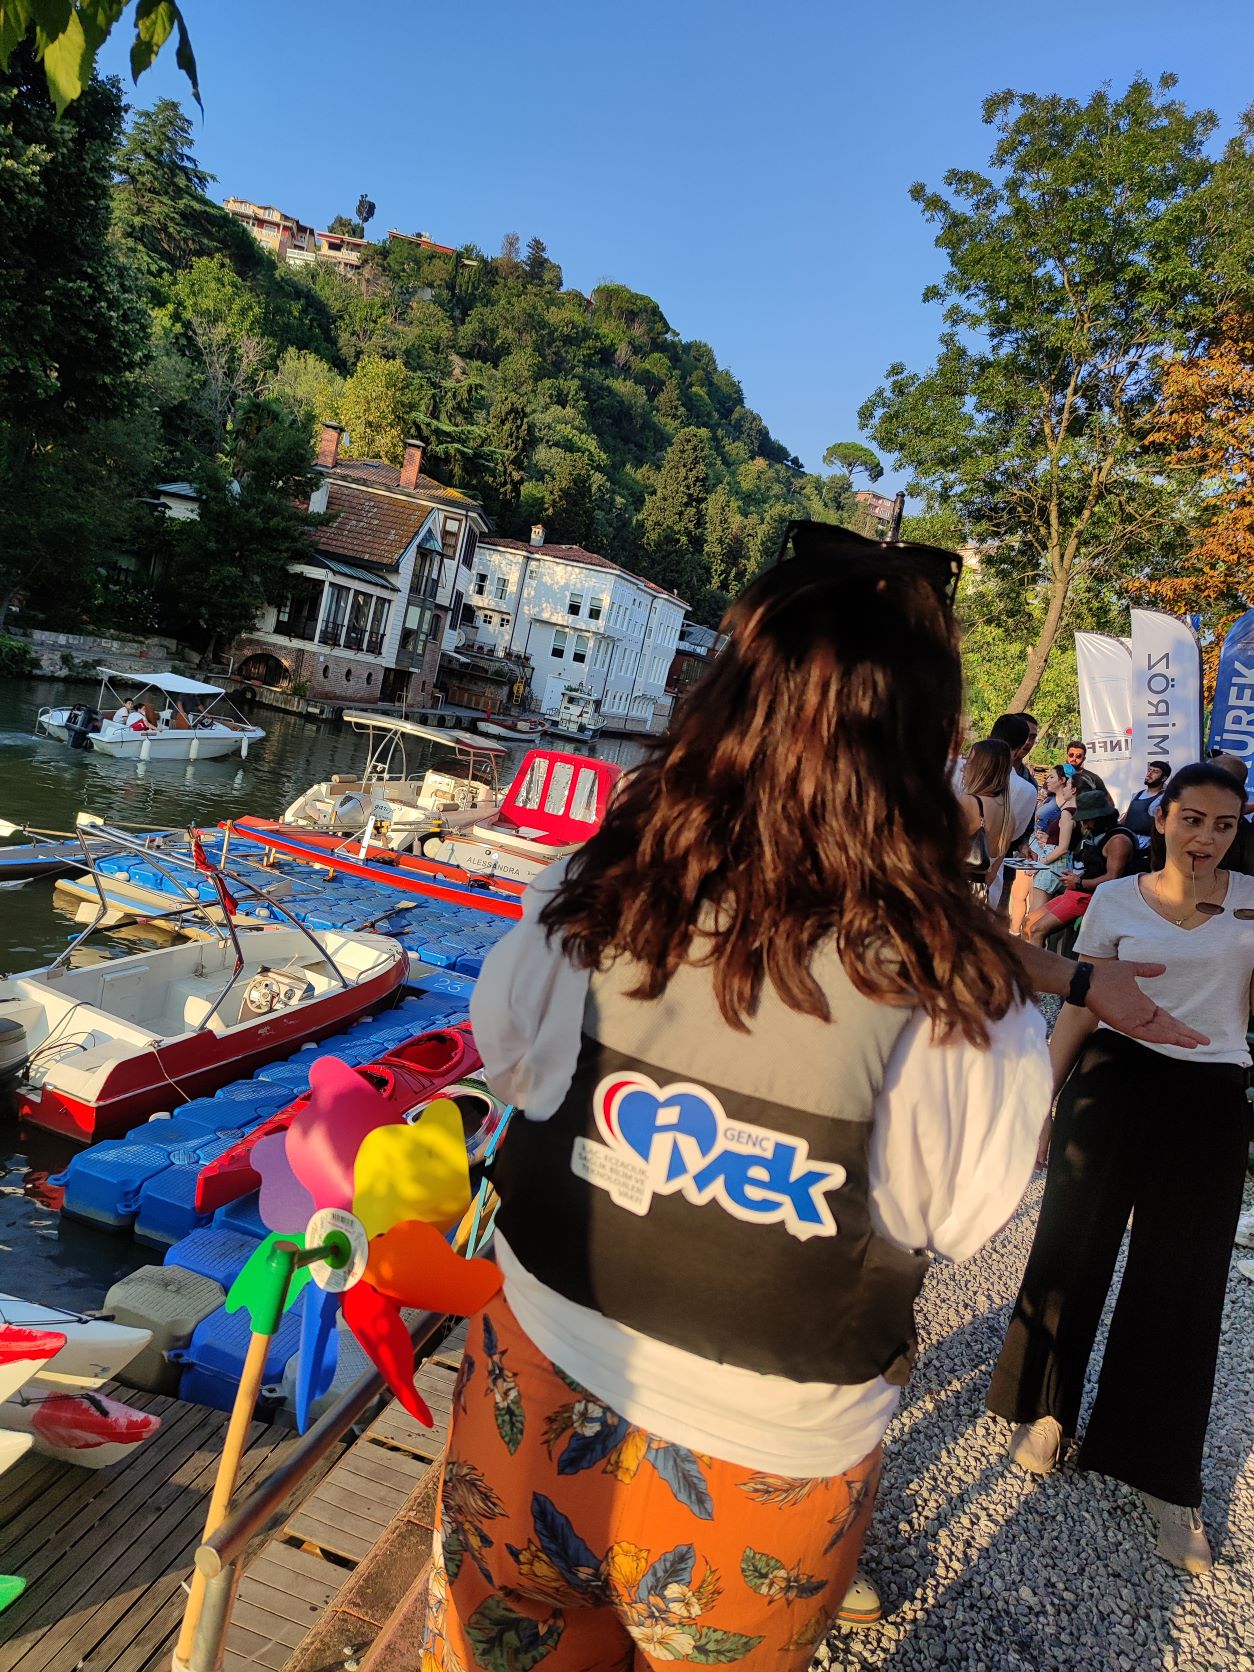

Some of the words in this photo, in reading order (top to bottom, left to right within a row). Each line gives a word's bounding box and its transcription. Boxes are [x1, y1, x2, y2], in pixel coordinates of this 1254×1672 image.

[1214, 661, 1254, 783] ÜREK
[466, 856, 520, 876] ALESSANDRA
[432, 977, 464, 993] 23
